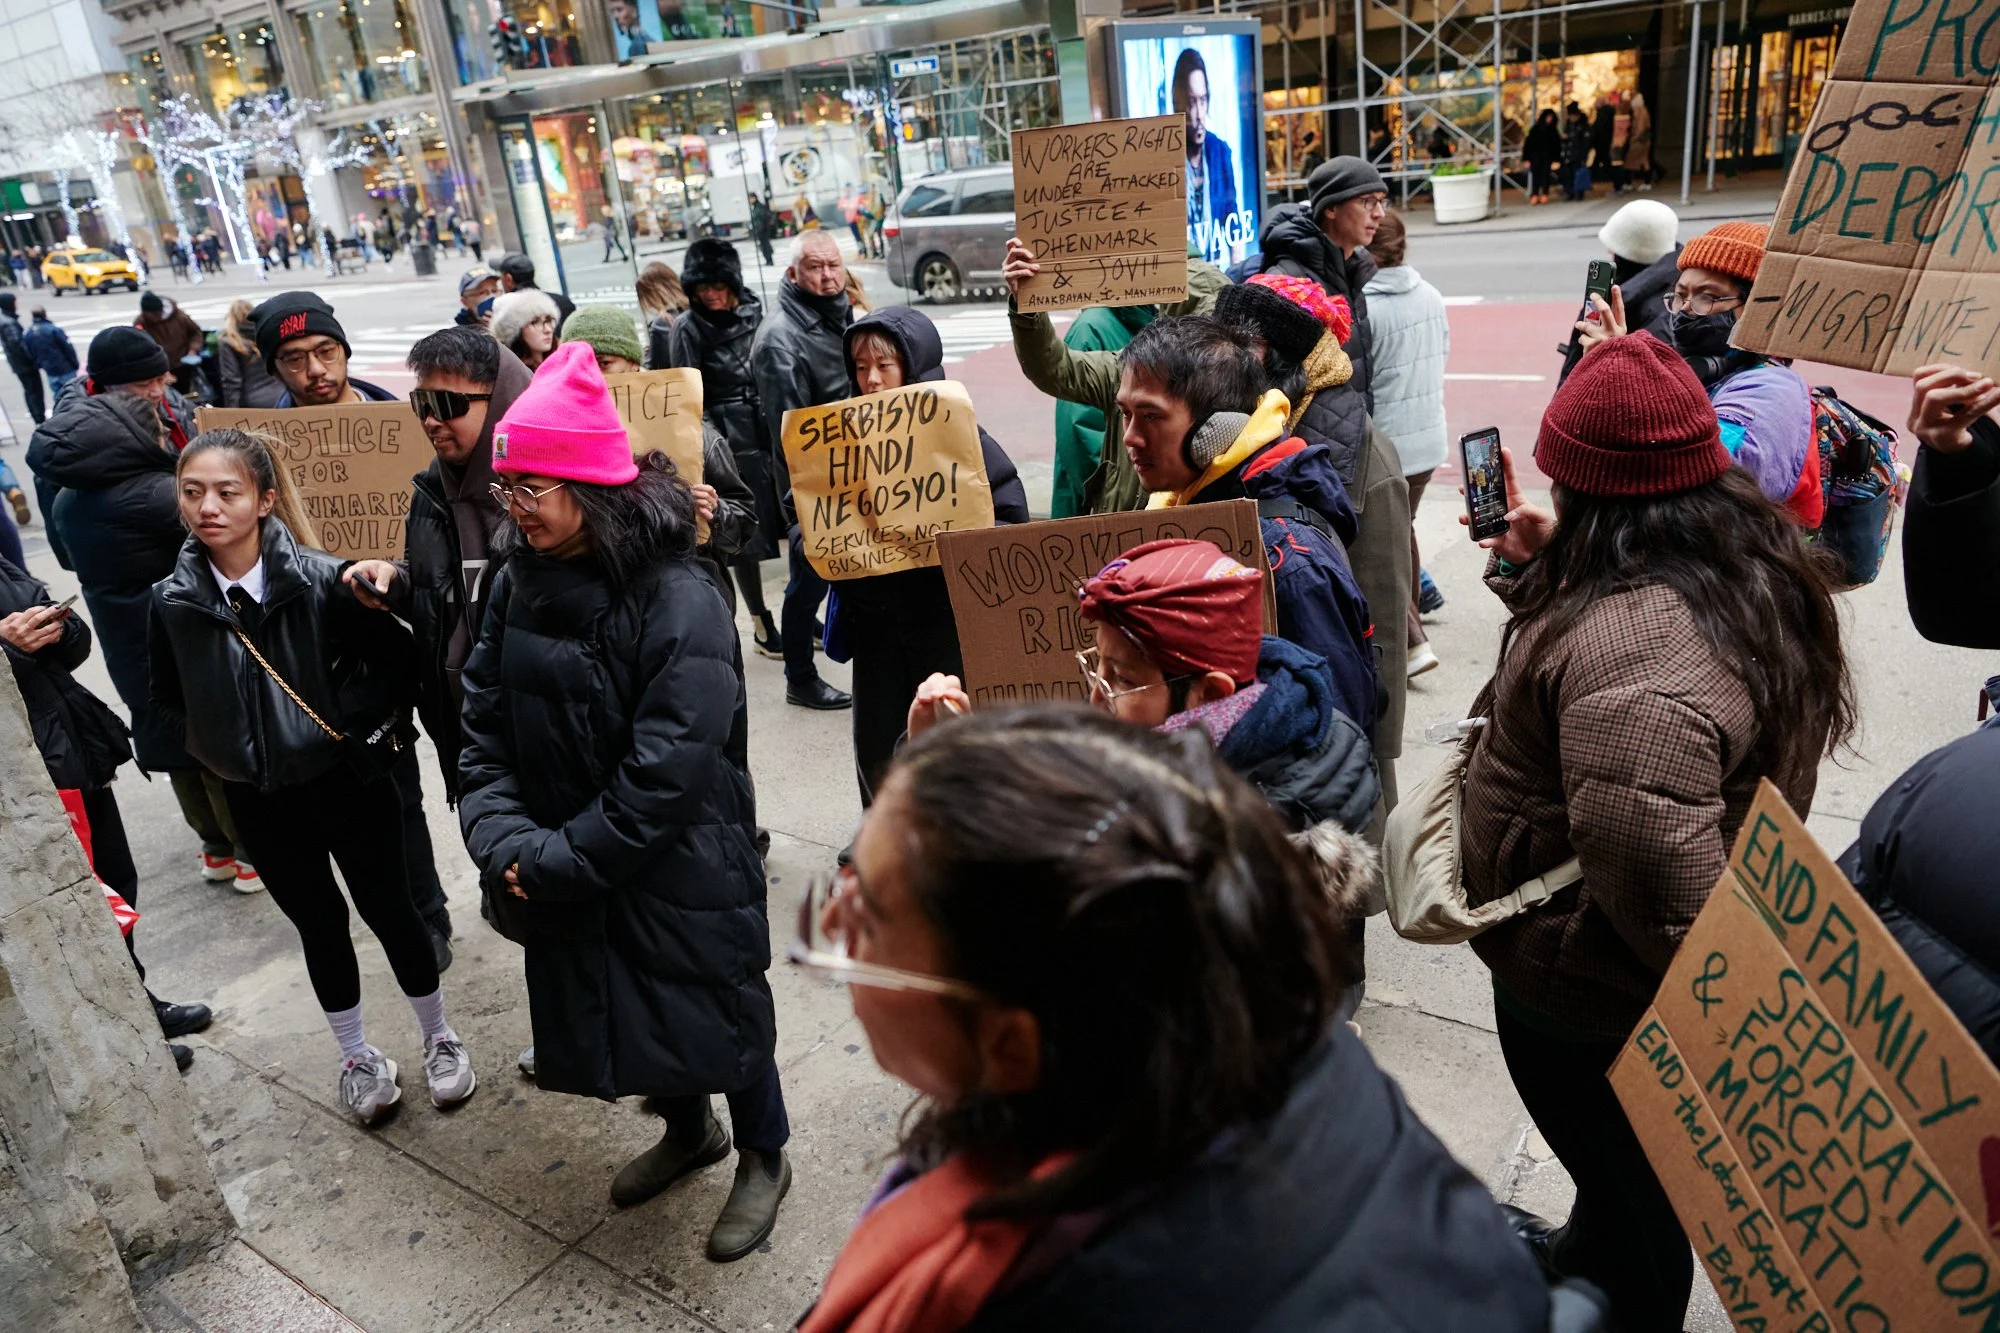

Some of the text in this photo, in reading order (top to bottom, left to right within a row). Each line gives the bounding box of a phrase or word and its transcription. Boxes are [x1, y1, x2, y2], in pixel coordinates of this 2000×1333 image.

[1020, 125, 1183, 174] WORKERS RIGHTS
[1024, 172, 1180, 206] UNDER ATTACKED
[1066, 161, 1110, 185] ARE
[1022, 201, 1129, 234] JUSTICE
[1187, 209, 1255, 256] VAGE
[1032, 229, 1157, 260] DHENMARK
[1053, 255, 1159, 289] & JOVI!!
[1028, 292, 1091, 307] ANAKBAYAN
[1124, 286, 1186, 301] MANHATTAN
[608, 380, 685, 423] TICE
[799, 388, 951, 452] SERBISYO,
[235, 416, 400, 461] USTICE
[291, 459, 349, 487] FOR
[829, 435, 914, 489] HINDI
[301, 490, 410, 519] NMARK
[812, 462, 958, 532] NEGOSYO!
[322, 519, 401, 553] OVI!
[915, 519, 954, 541] NOT
[828, 544, 932, 576] BUSINESS!
[959, 523, 1253, 607] WORK,
[1019, 606, 1099, 654] RIG
[1742, 811, 1980, 1128] END FAMILY
[1691, 951, 1869, 1230] & FORCED
[1636, 1020, 1684, 1089] END
[1675, 1093, 1706, 1145] the
[1738, 1208, 1807, 1314] Export
